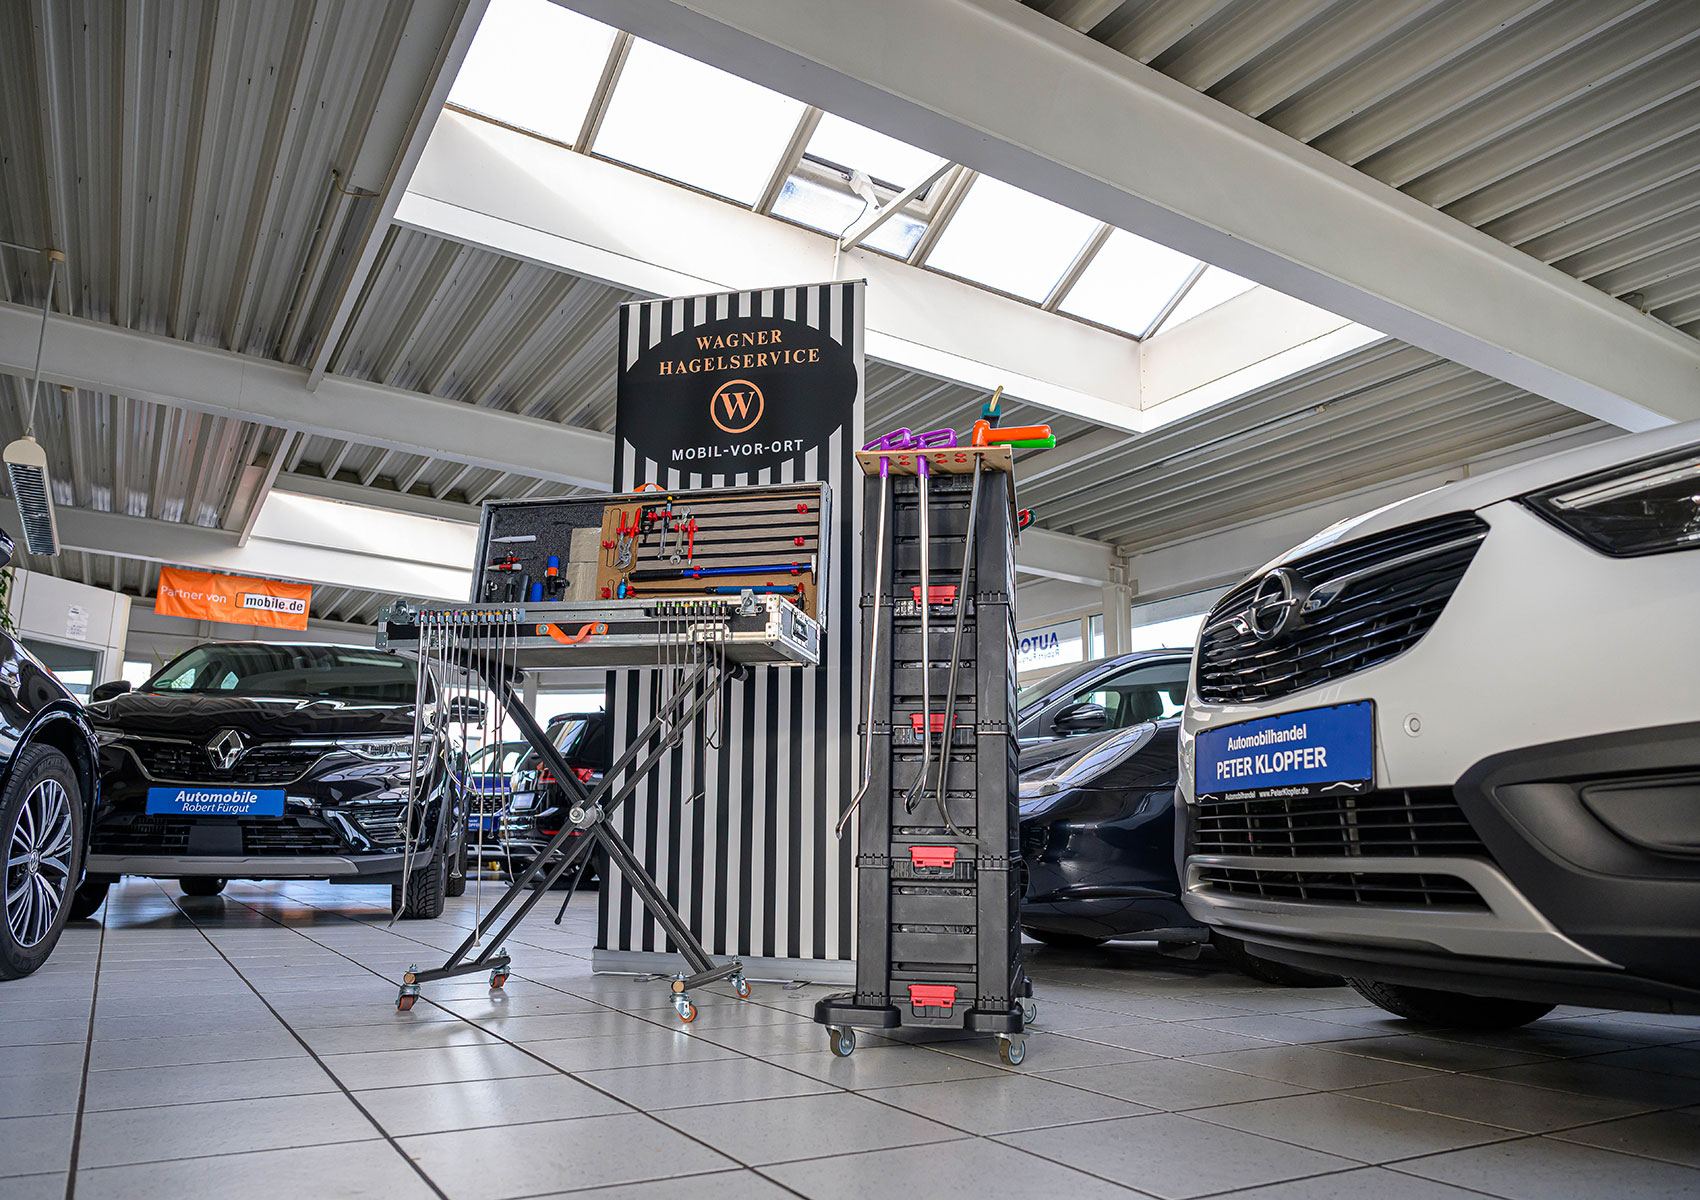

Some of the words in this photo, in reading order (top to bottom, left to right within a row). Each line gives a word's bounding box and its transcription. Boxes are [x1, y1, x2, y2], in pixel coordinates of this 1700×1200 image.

[696, 329, 783, 351] WAGNER
[659, 348, 820, 376] HAGELSERVICE
[720, 391, 756, 421] W
[671, 439, 804, 461] MOBIL-VOR-ORT
[160, 584, 204, 601] Partner
[206, 593, 227, 604] von
[245, 593, 304, 612] mobile.de
[1227, 723, 1307, 752] Automobilhandel
[1217, 757, 1253, 780] PETER
[1255, 746, 1328, 775] KLOPFER
[175, 790, 258, 803] Automobile
[182, 802, 216, 812] Robert
[216, 802, 250, 815] Fürgut
